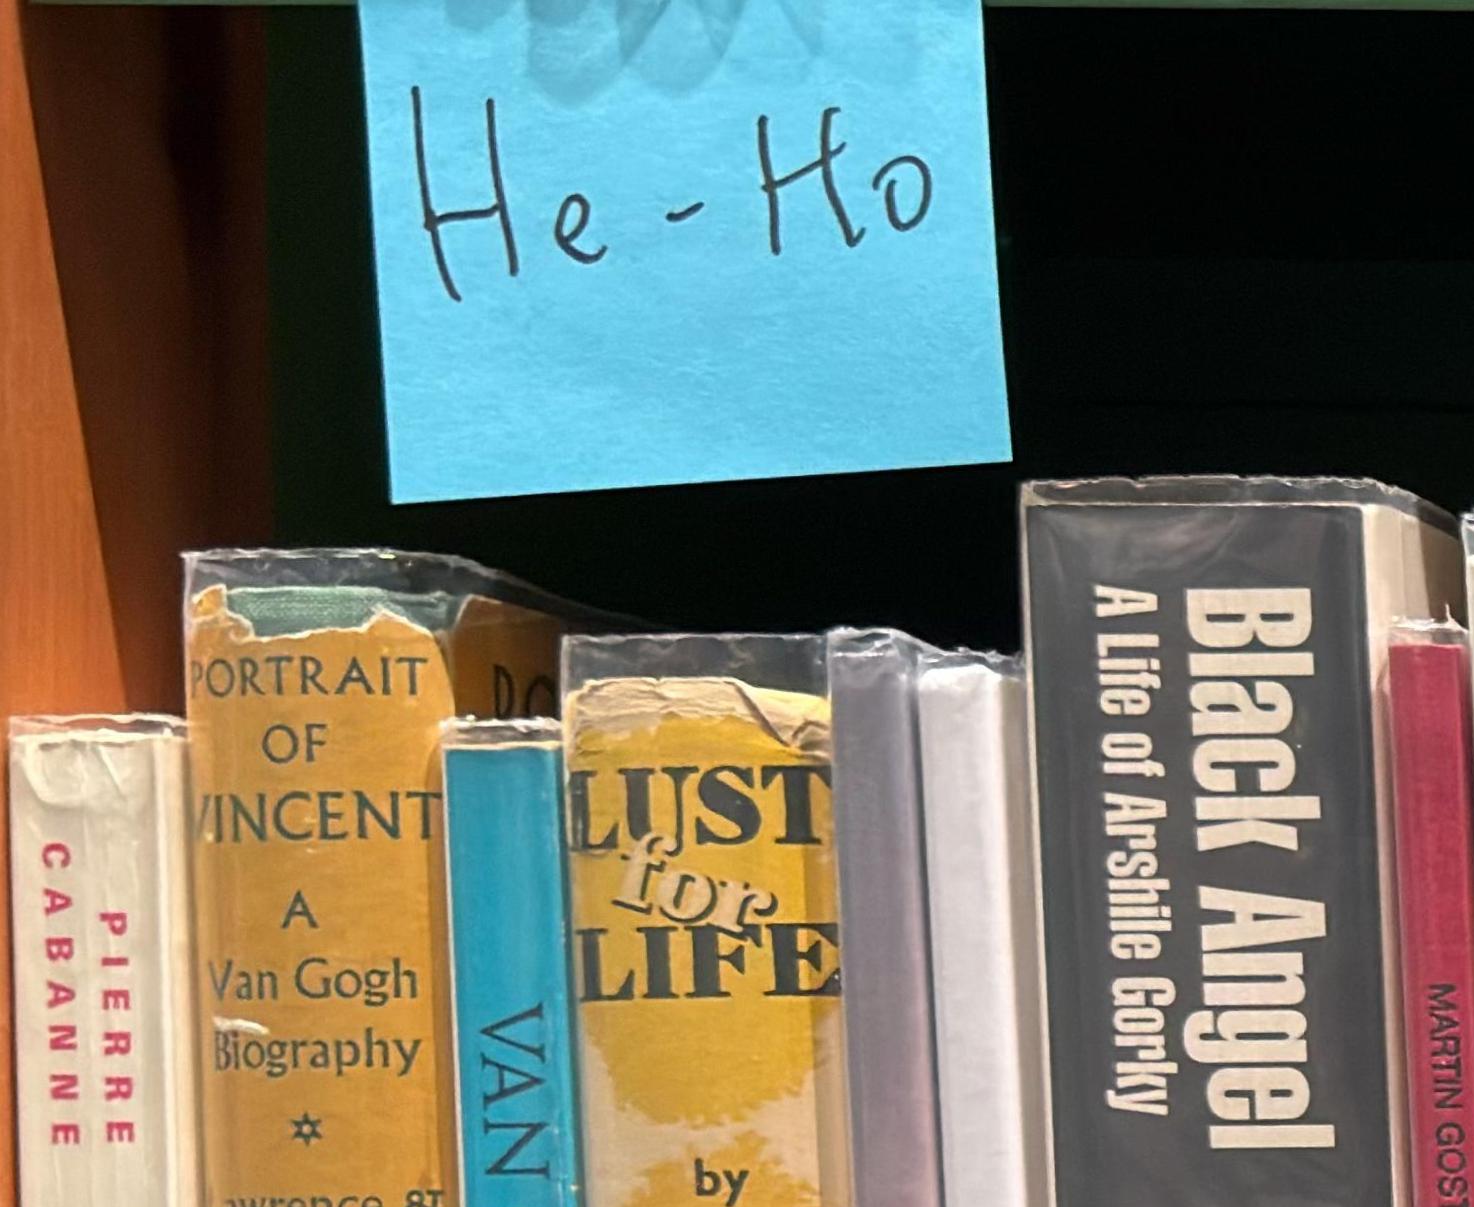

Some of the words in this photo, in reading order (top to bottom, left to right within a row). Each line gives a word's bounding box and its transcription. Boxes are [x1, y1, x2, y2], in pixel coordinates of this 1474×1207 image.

[411, 86, 608, 301] He
[757, 106, 932, 255] Ho
[1093, 584, 1159, 617] A
[191, 655, 428, 698] PORTRAIT
[1097, 632, 1163, 717] Life
[1186, 587, 1322, 852] Black
[262, 723, 328, 764] OF
[1100, 732, 1166, 779] of
[569, 763, 834, 857] LUST
[281, 890, 319, 930] A
[611, 831, 779, 941] for
[1104, 792, 1173, 961] Arshile
[42, 842, 80, 1147] CABANNE
[209, 959, 281, 1002] Van
[293, 957, 418, 1009] Gogh
[576, 921, 842, 1002] LIFE
[99, 911, 135, 1145] PIERRE
[212, 1030, 423, 1083] Biography
[1105, 976, 1179, 1116] Gorky
[1183, 884, 1336, 1150] Angel
[1429, 982, 1464, 1111] MARTIN
[478, 1002, 551, 1181] VAN
[694, 1157, 748, 1207] by
